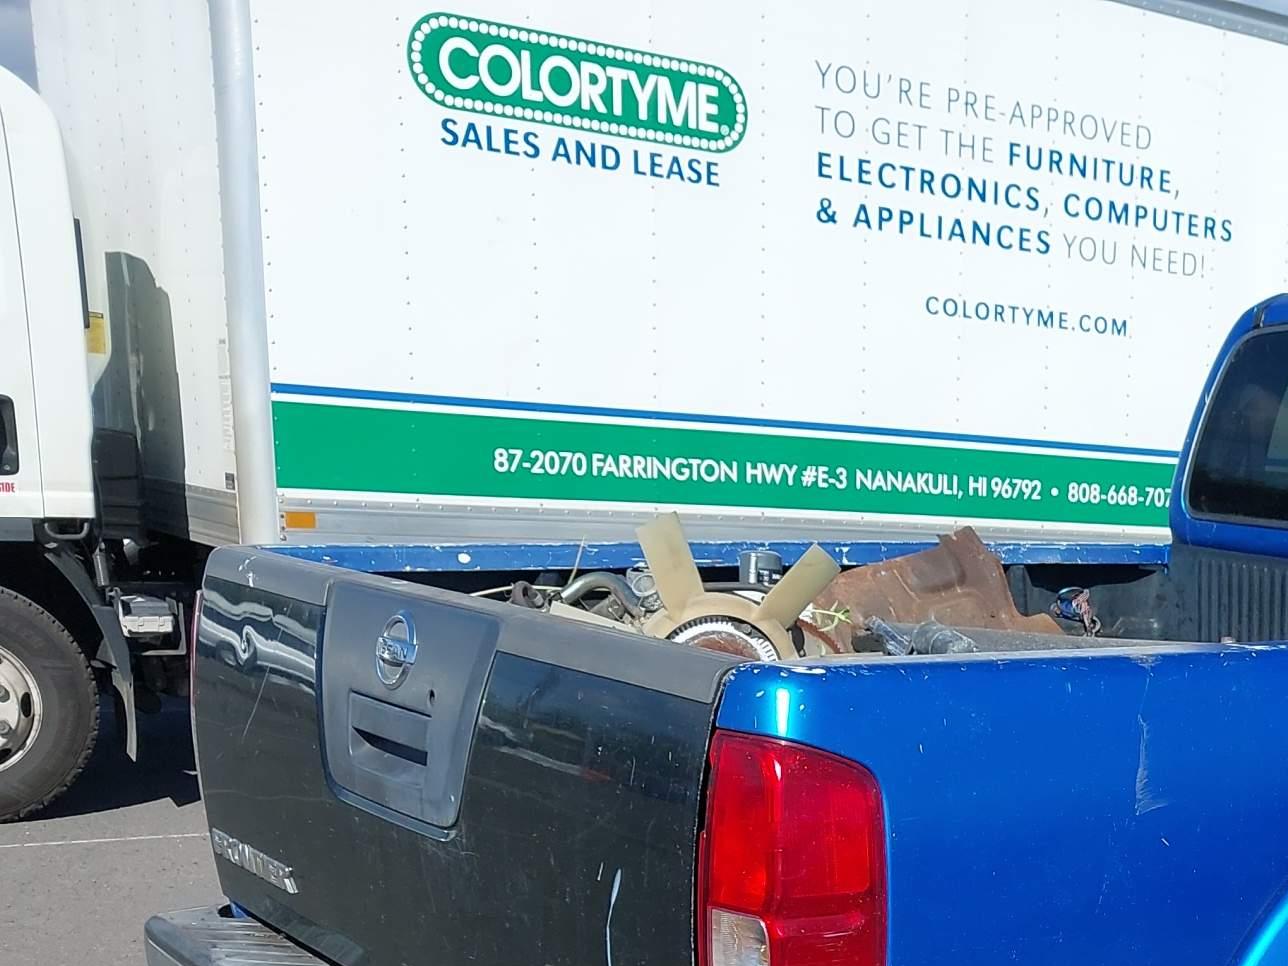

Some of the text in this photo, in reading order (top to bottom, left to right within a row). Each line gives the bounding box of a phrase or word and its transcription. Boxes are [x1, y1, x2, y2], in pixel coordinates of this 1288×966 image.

[438, 36, 720, 134] COLORTYME
[947, 87, 1152, 151] PRE-APPROVED
[440, 118, 720, 187] SALES AND LEASE
[815, 106, 1180, 200] TO GET THE FURNITURE,
[817, 152, 1233, 243] ELECTRONICS, COMPUTERS
[816, 197, 1206, 279] & APPLIANCES YOU NEED!
[925, 296, 1128, 338] COLORTYME.COM
[0, 482, 16, 493] IDE
[494, 448, 1171, 508] 87-2070 FARRINGTON HWY #E-3 NANAKULI, HI 96792 808-668-707
